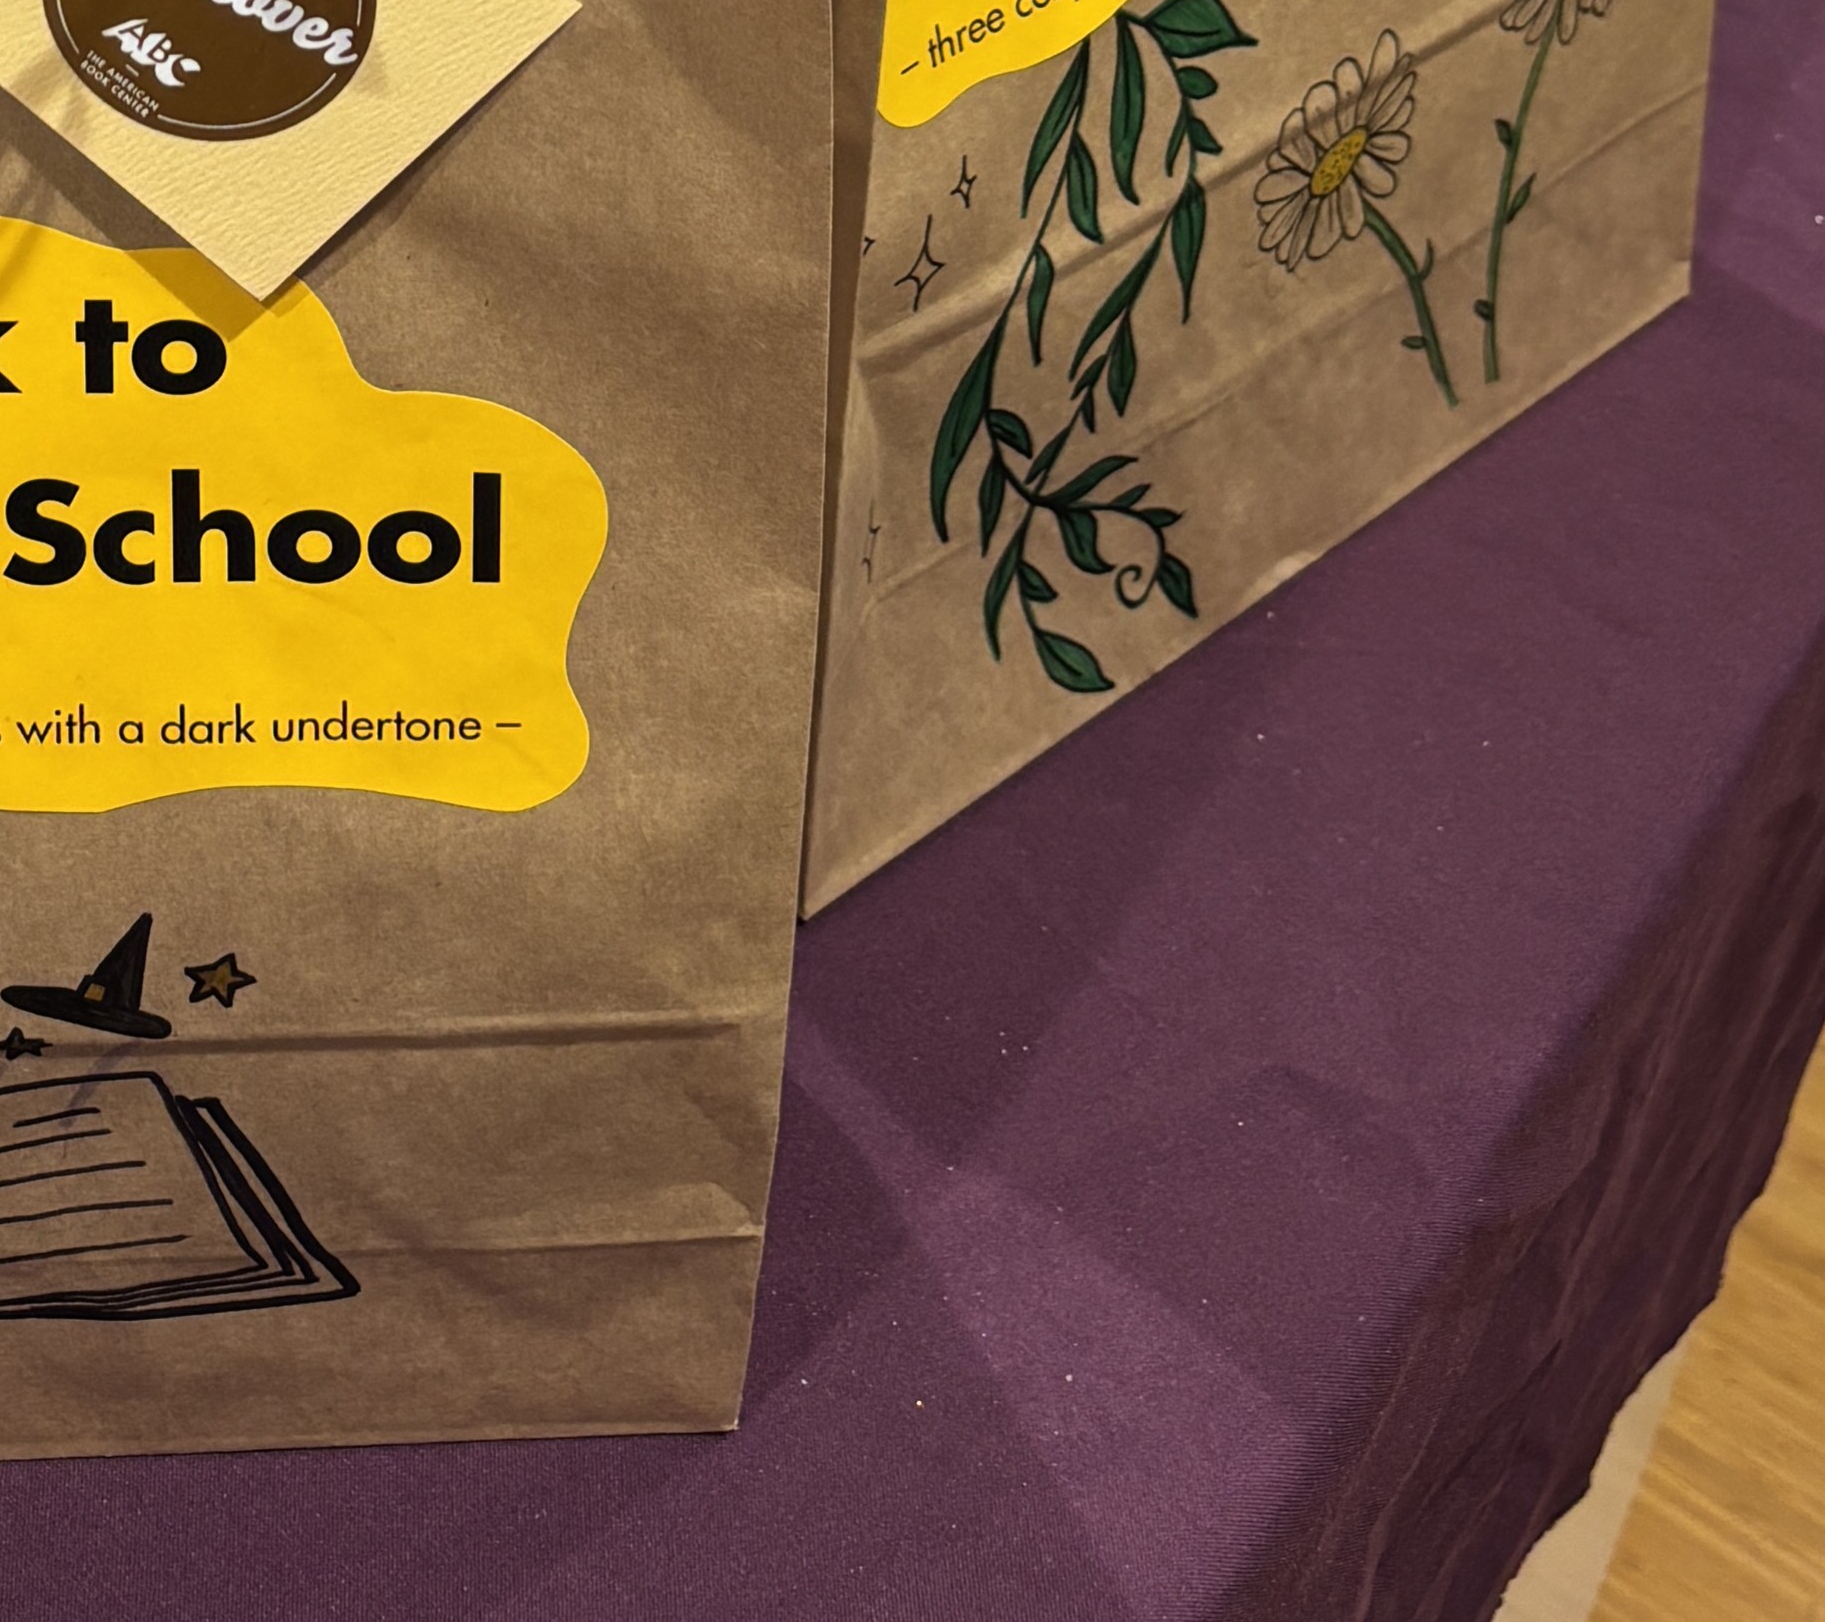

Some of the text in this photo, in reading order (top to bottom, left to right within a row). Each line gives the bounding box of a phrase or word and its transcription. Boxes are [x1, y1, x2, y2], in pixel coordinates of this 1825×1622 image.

[101, 17, 201, 87] ABC
[926, 10, 1007, 71] three
[79, 59, 151, 119] BOOK CENTER
[86, 50, 159, 112] THE AMERICAN
[74, 297, 228, 396] to
[2, 468, 503, 587] School
[16, 704, 101, 745] with
[118, 715, 146, 745] a
[160, 702, 257, 744] dark
[270, 700, 483, 743] undertone
